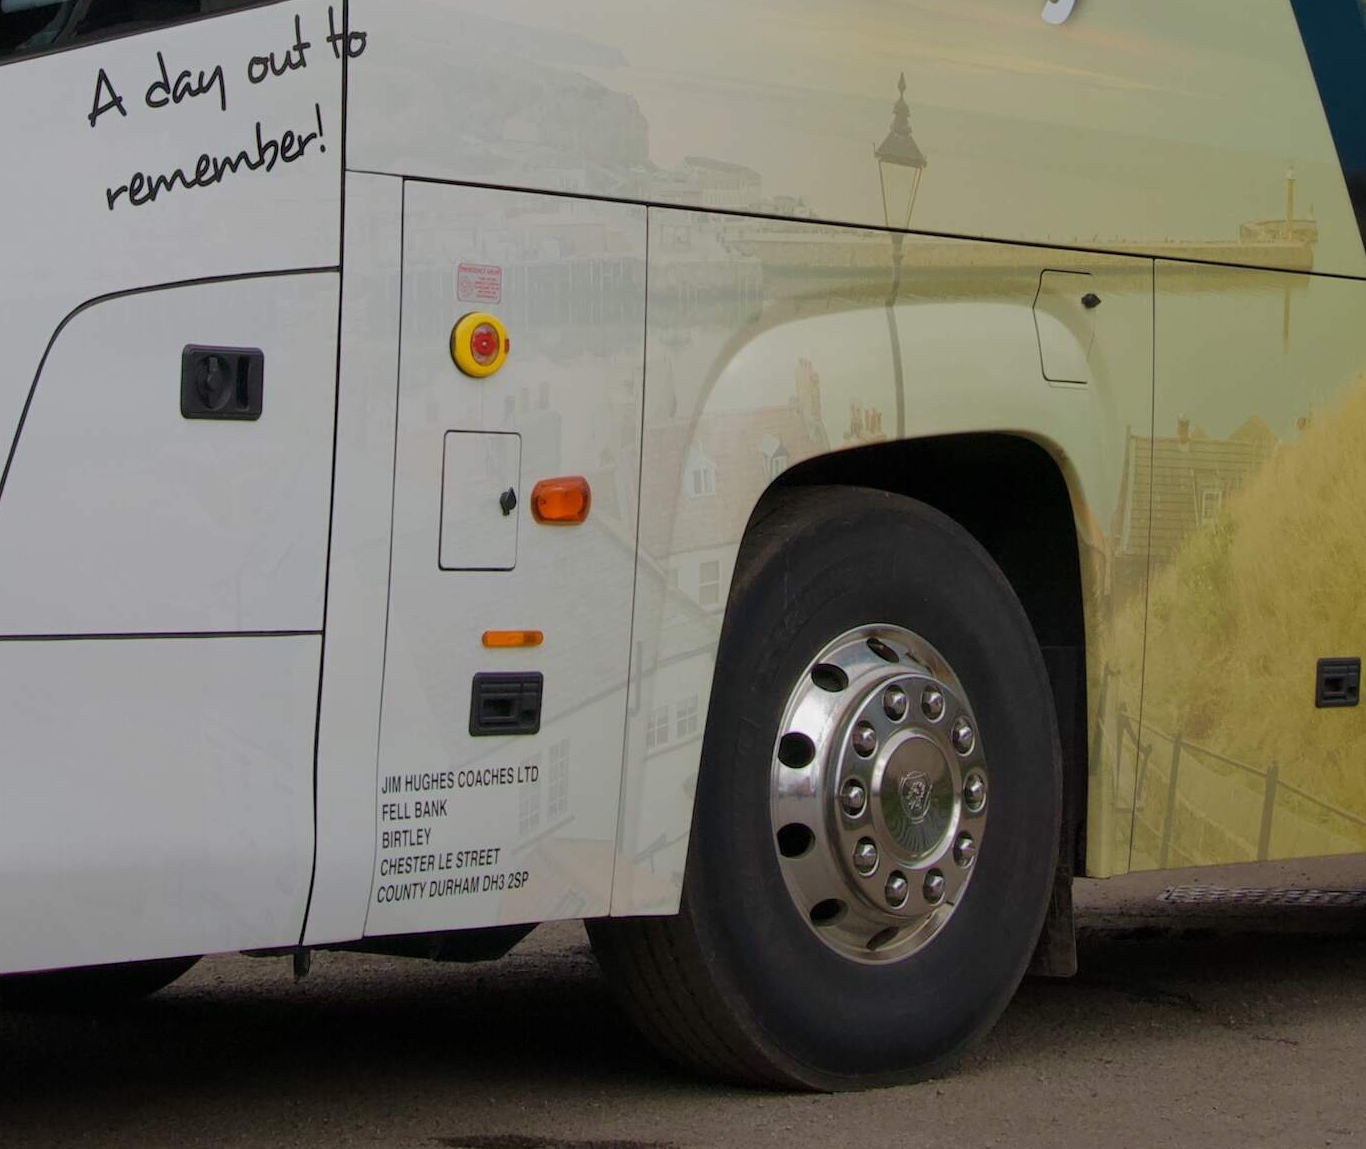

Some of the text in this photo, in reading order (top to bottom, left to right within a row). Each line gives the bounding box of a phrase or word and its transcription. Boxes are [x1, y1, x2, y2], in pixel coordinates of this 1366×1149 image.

[87, 5, 368, 128] A day out to
[105, 101, 327, 211] remember!
[381, 765, 539, 794] JIM HUGHES COACHES LTD
[381, 798, 448, 821] FELL BANK
[381, 827, 432, 849] BIRTLEY
[380, 847, 501, 877] CHESTER LE STREET
[377, 871, 530, 904] COUNTY DURHAM DH3 2SP
